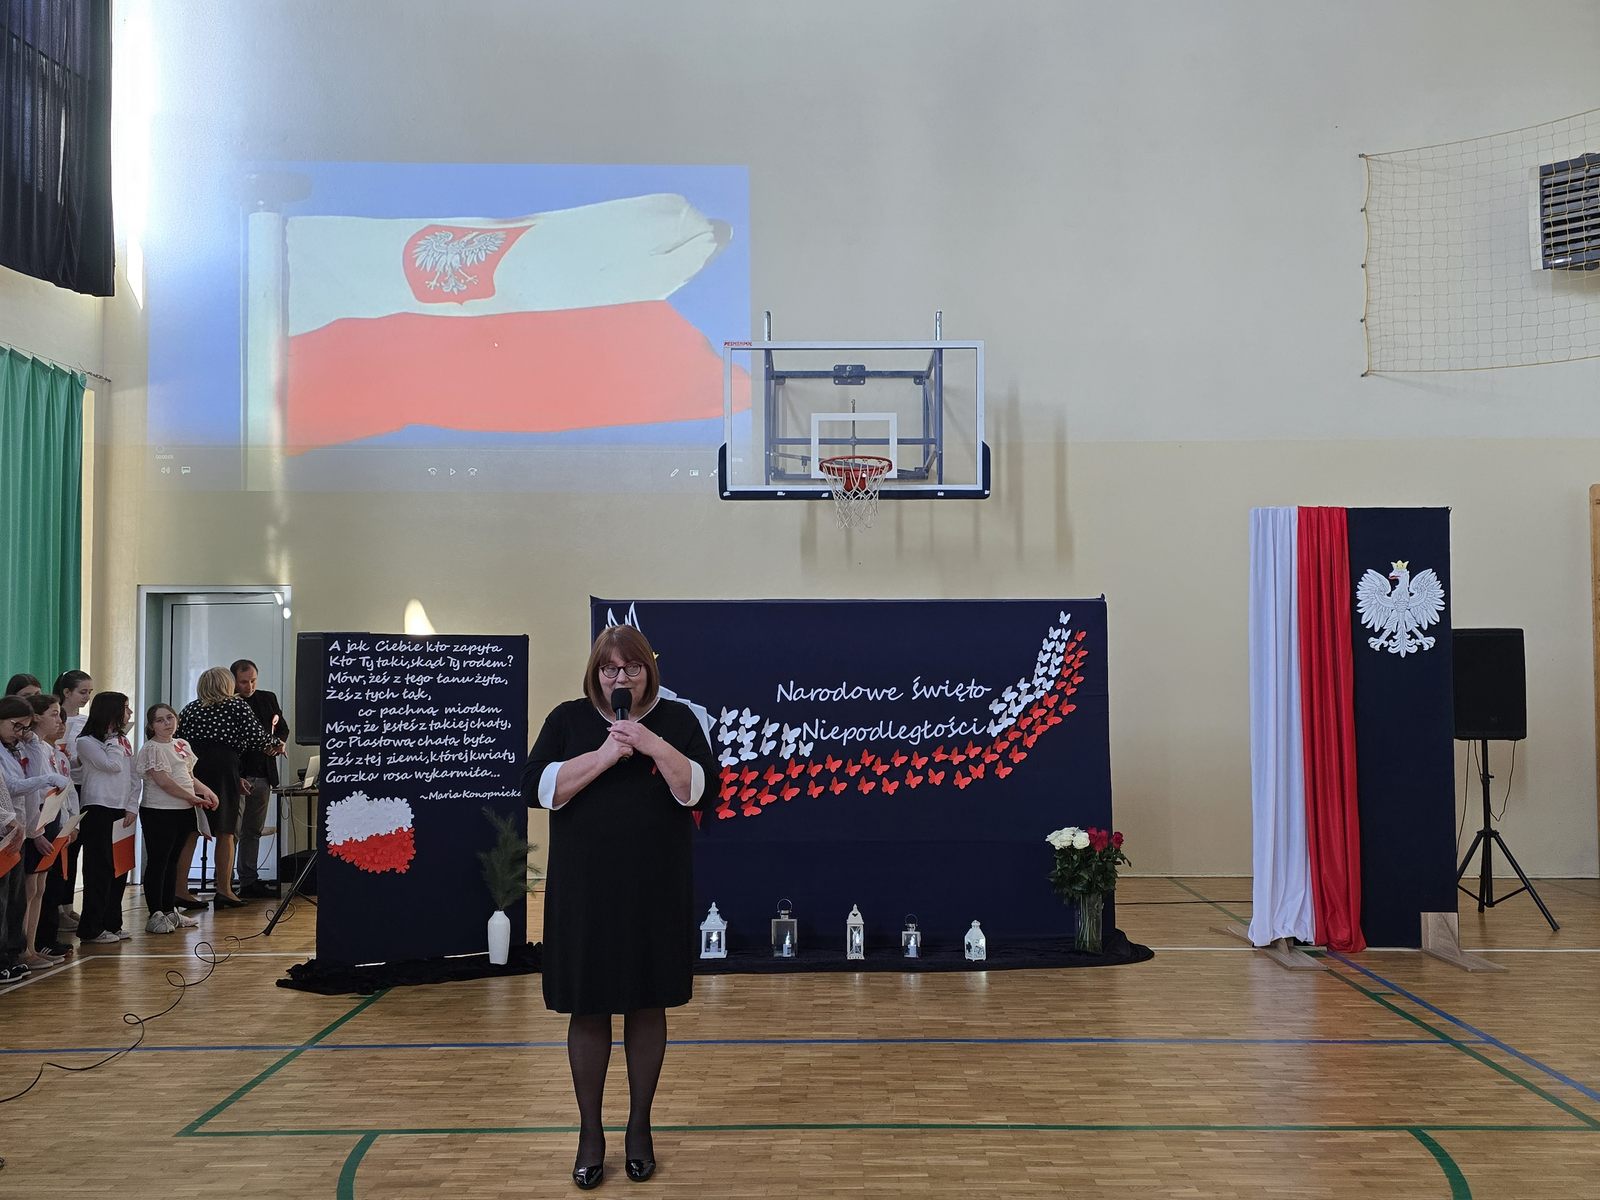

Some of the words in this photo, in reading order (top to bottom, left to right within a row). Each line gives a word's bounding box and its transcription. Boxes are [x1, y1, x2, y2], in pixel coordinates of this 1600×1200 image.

[328, 640, 341, 652] A
[345, 639, 370, 654] jak
[375, 640, 424, 652] Ciebie
[426, 641, 451, 653] kto
[452, 643, 503, 656] zapyta
[329, 655, 357, 667] Kto
[358, 656, 374, 671] Ty
[447, 655, 461, 671] Ty
[462, 654, 514, 668] rodem?
[328, 671, 366, 686] Mów,
[368, 671, 391, 685] żeś
[392, 675, 402, 684] z
[404, 673, 434, 686] tego
[474, 673, 509, 687] żyta,
[325, 686, 354, 702] Żeś
[353, 691, 363, 700] z
[365, 688, 400, 703] tych
[776, 680, 904, 703] Narodowe
[358, 708, 377, 717] co
[380, 704, 440, 719] pachną
[444, 702, 503, 714] miodem
[325, 720, 362, 735] Mów,
[363, 720, 380, 733] że
[381, 718, 419, 734] jesteś
[418, 722, 428, 731] z
[428, 718, 469, 732] takiej
[469, 717, 512, 731] chaty,
[802, 716, 987, 746] Niepodległości
[325, 737, 347, 750] Co
[348, 735, 417, 748] Piastową
[417, 734, 461, 747] chatą
[326, 752, 355, 767] Żeś
[354, 757, 364, 766] z
[364, 752, 382, 767] tej
[469, 748, 516, 764] kwiaty
[325, 770, 380, 783] Gorzka
[383, 772, 413, 782] rosa
